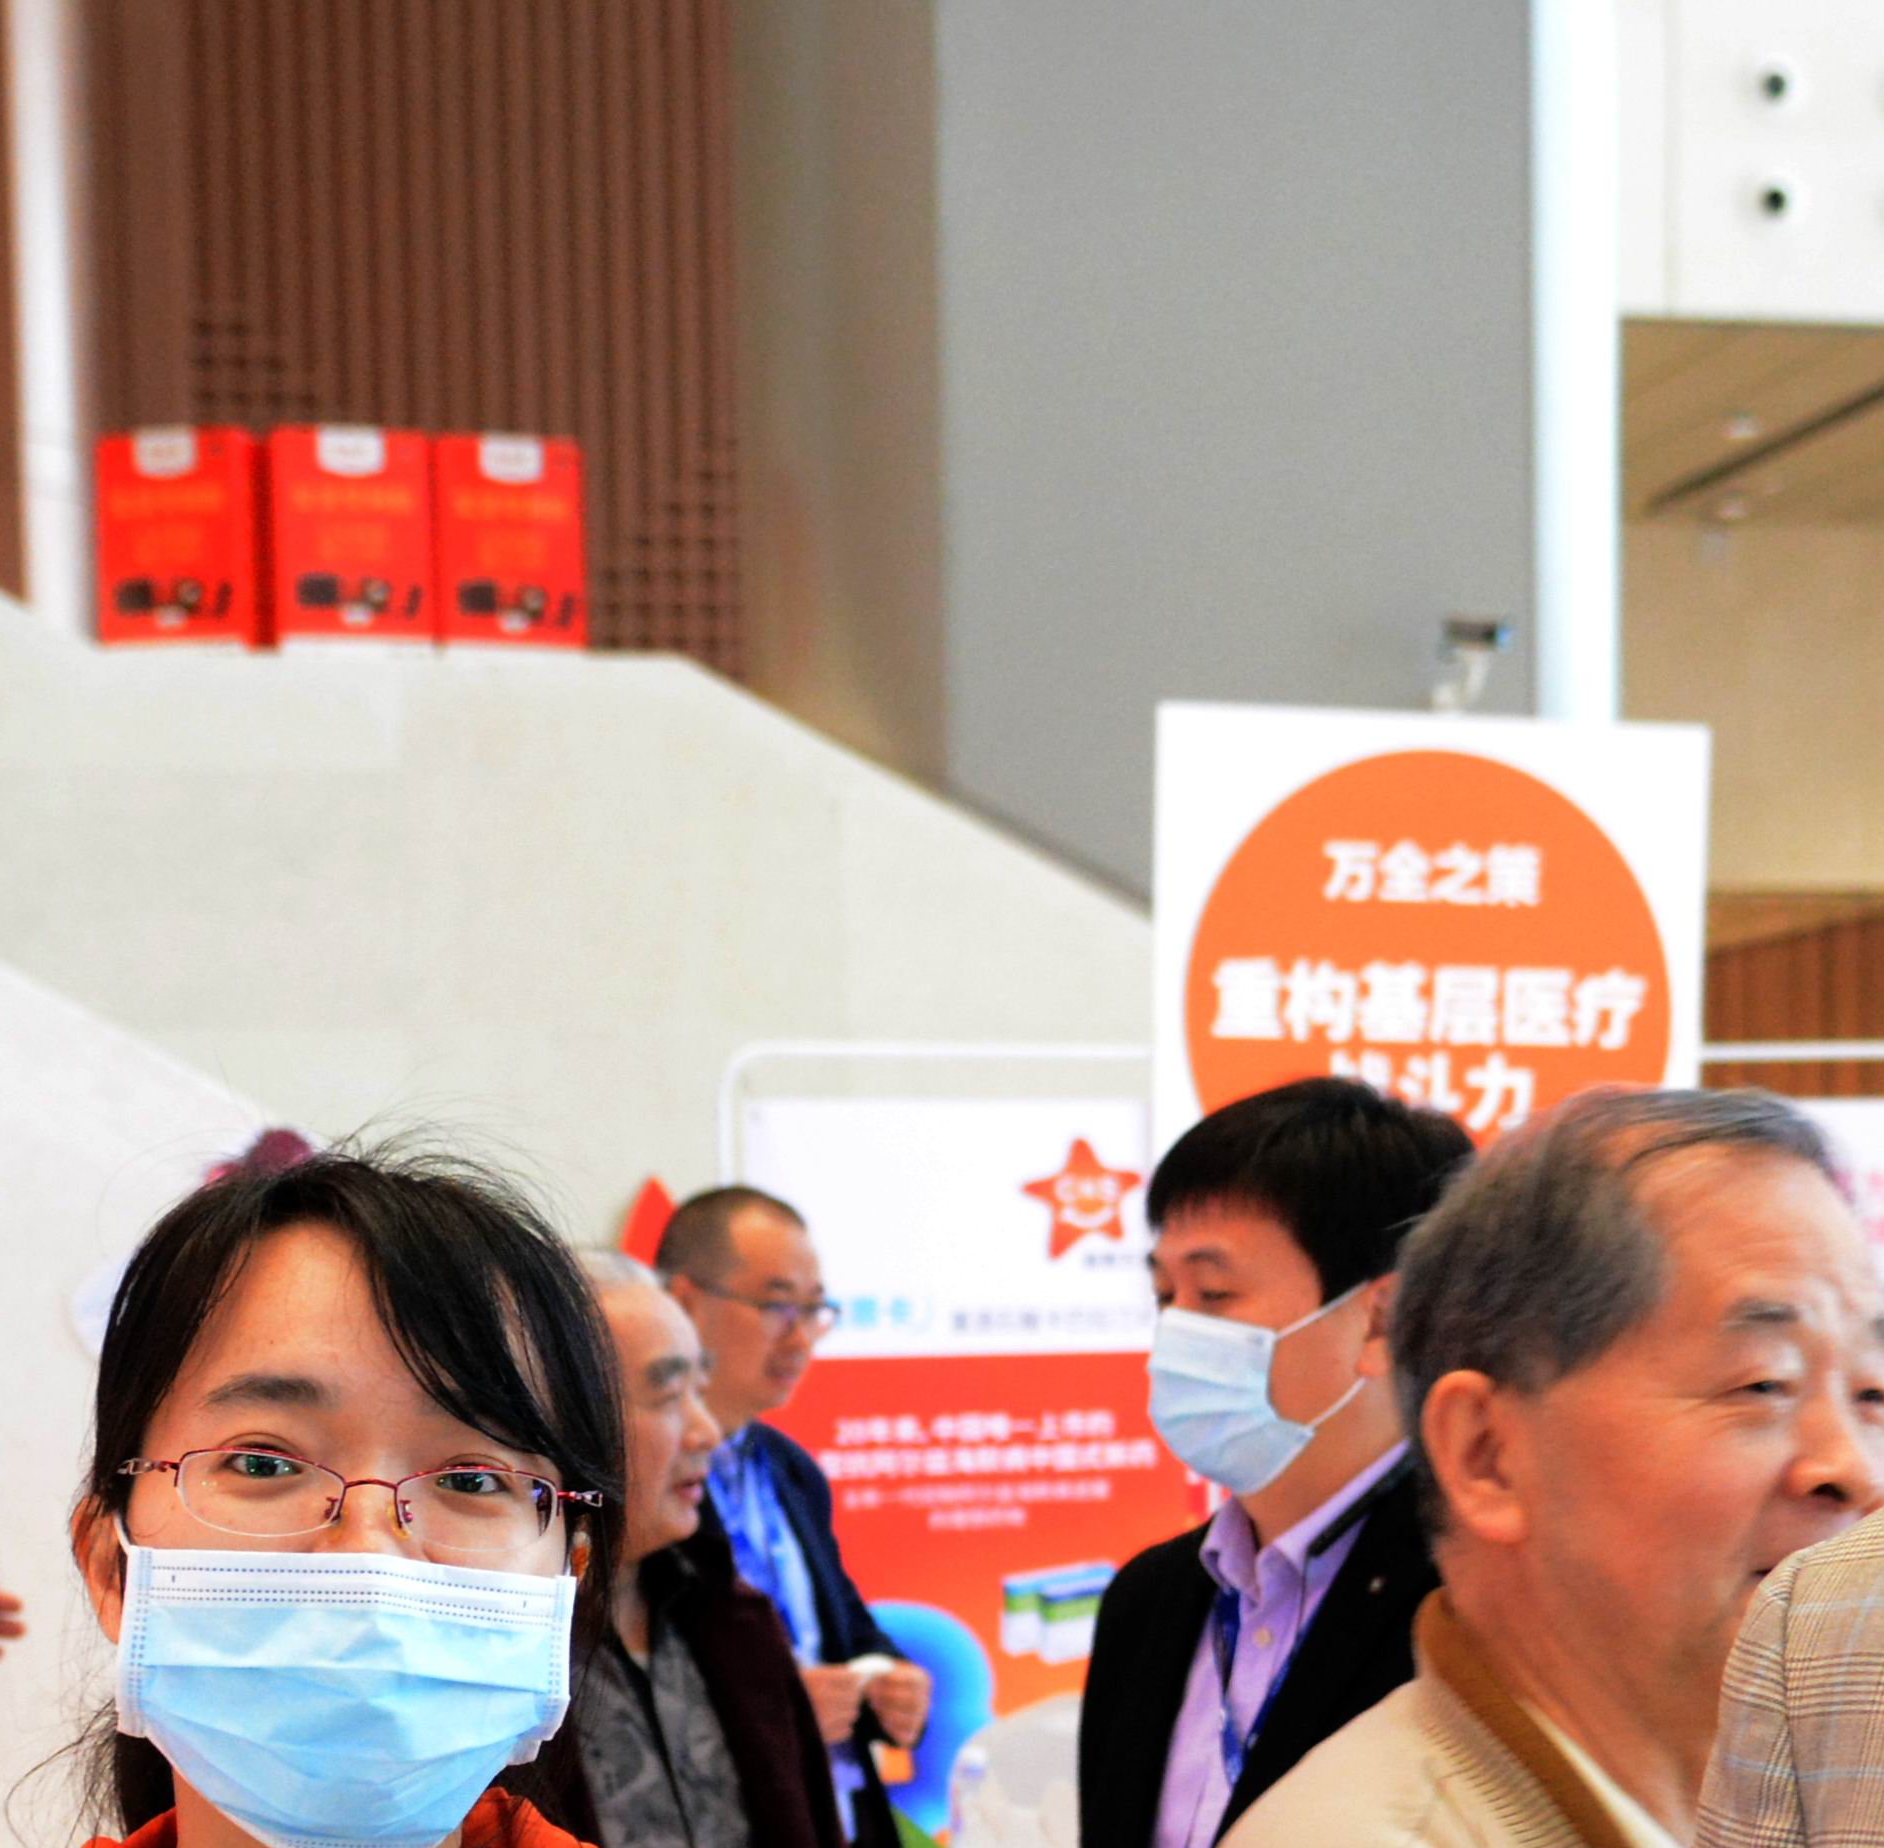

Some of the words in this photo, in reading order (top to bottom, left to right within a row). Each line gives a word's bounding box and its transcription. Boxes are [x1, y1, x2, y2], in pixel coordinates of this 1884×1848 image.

[1211, 956, 1648, 1050] 重构基层医疗
